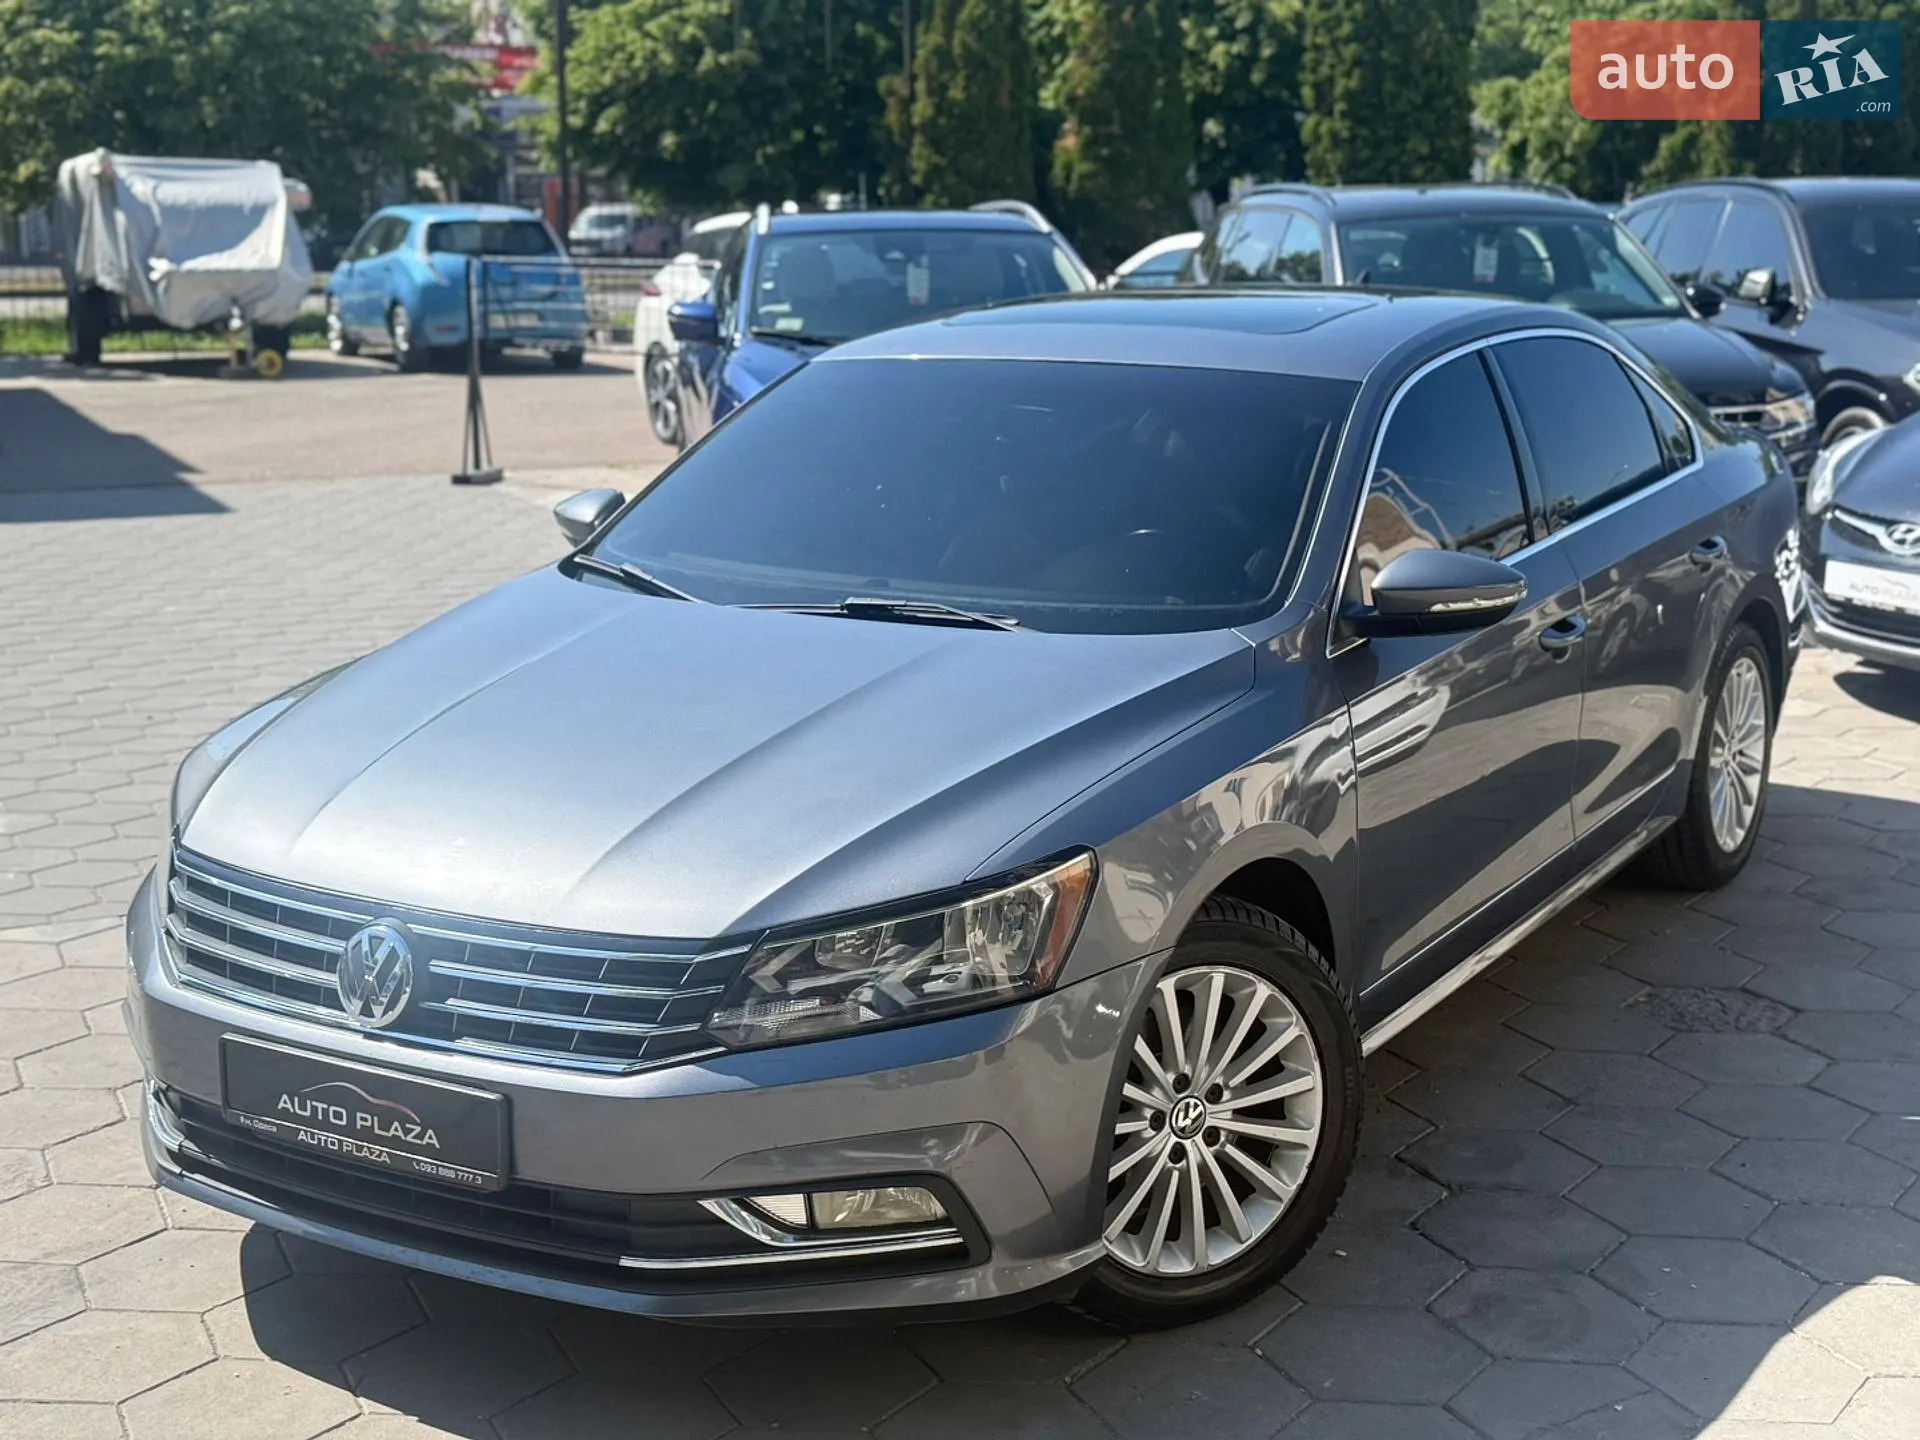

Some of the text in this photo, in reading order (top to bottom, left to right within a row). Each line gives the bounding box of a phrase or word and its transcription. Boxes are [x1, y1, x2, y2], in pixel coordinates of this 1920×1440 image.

[277, 1093, 441, 1149] AUTO PLAZA
[297, 1130, 391, 1164] AUTO PLAZA
[475, 1175, 482, 1185] 3
